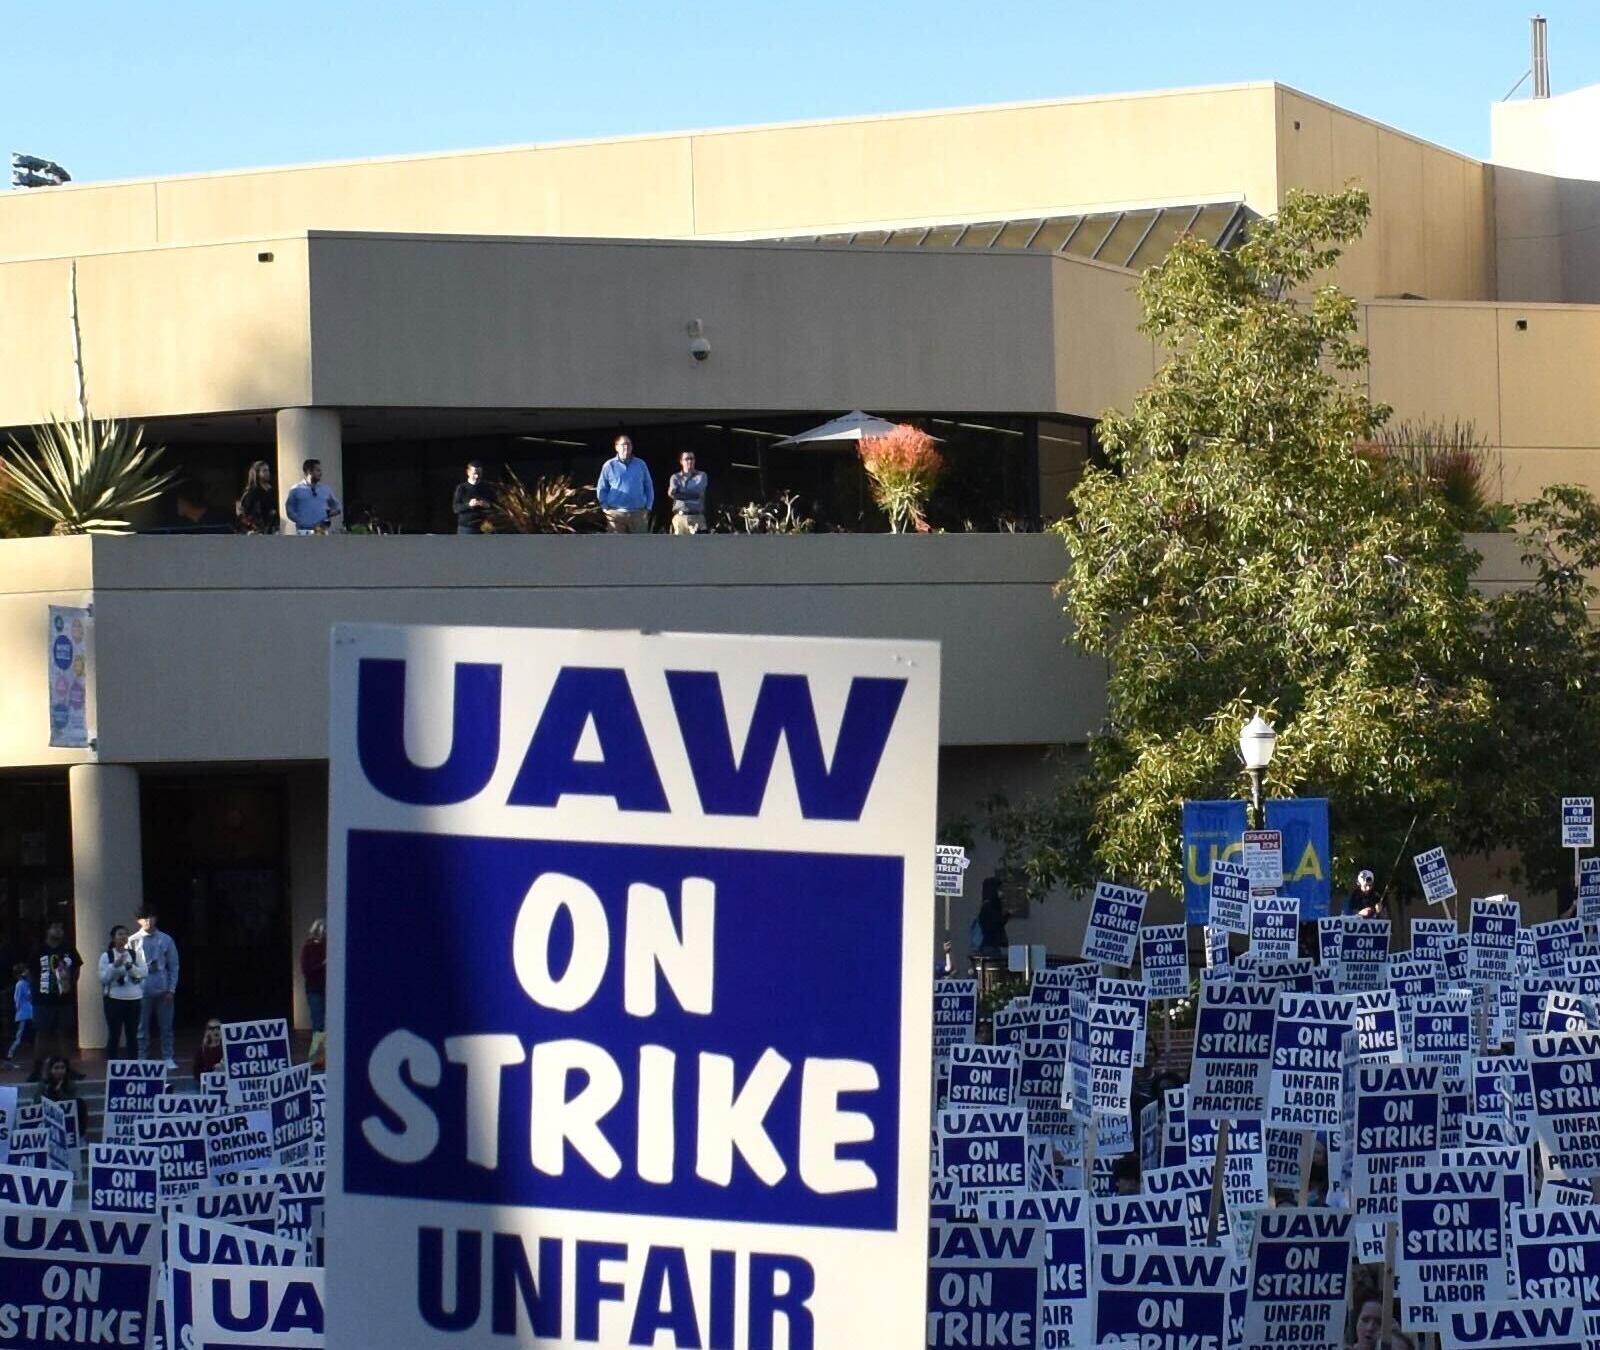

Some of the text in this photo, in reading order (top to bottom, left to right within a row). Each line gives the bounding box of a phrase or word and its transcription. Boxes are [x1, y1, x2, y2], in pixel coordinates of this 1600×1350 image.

[355, 656, 904, 820] UAW
[1188, 840, 1325, 886] UA
[1215, 861, 1250, 876] UAW
[1224, 876, 1239, 887] ON
[1213, 885, 1248, 900] STRIKE
[511, 869, 717, 1019] ON
[206, 1116, 249, 1137] OUR
[361, 1029, 880, 1196] STRIKE
[209, 1146, 272, 1167] NDITIONS
[3, 1215, 152, 1255] UAW
[41, 1264, 102, 1302] ON
